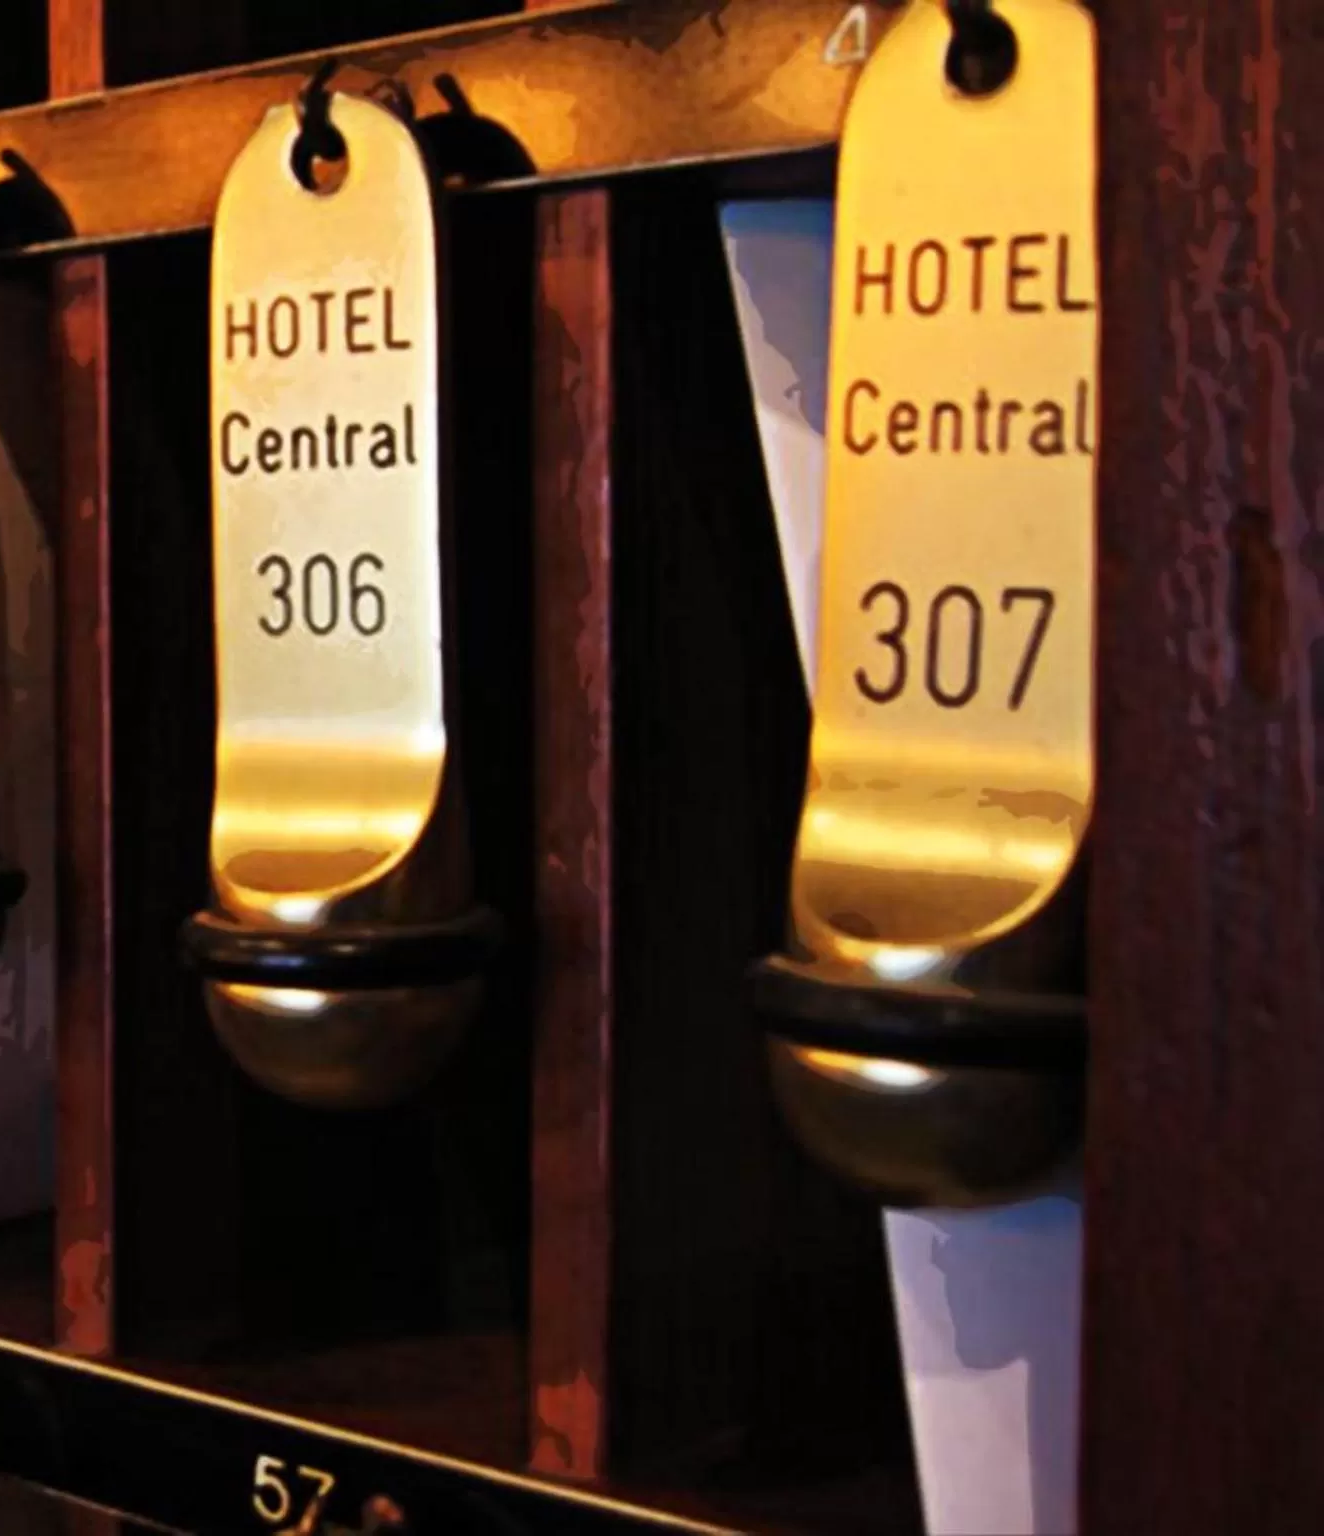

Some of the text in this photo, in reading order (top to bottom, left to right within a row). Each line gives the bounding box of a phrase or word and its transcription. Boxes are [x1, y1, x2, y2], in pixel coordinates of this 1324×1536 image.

[854, 233, 1095, 317] HOTEL
[225, 287, 412, 361] HOTEL
[220, 403, 417, 476] Central
[844, 378, 1094, 456] Central
[257, 553, 386, 637] 306
[853, 580, 1057, 712] 307
[252, 1454, 336, 1526] 57
